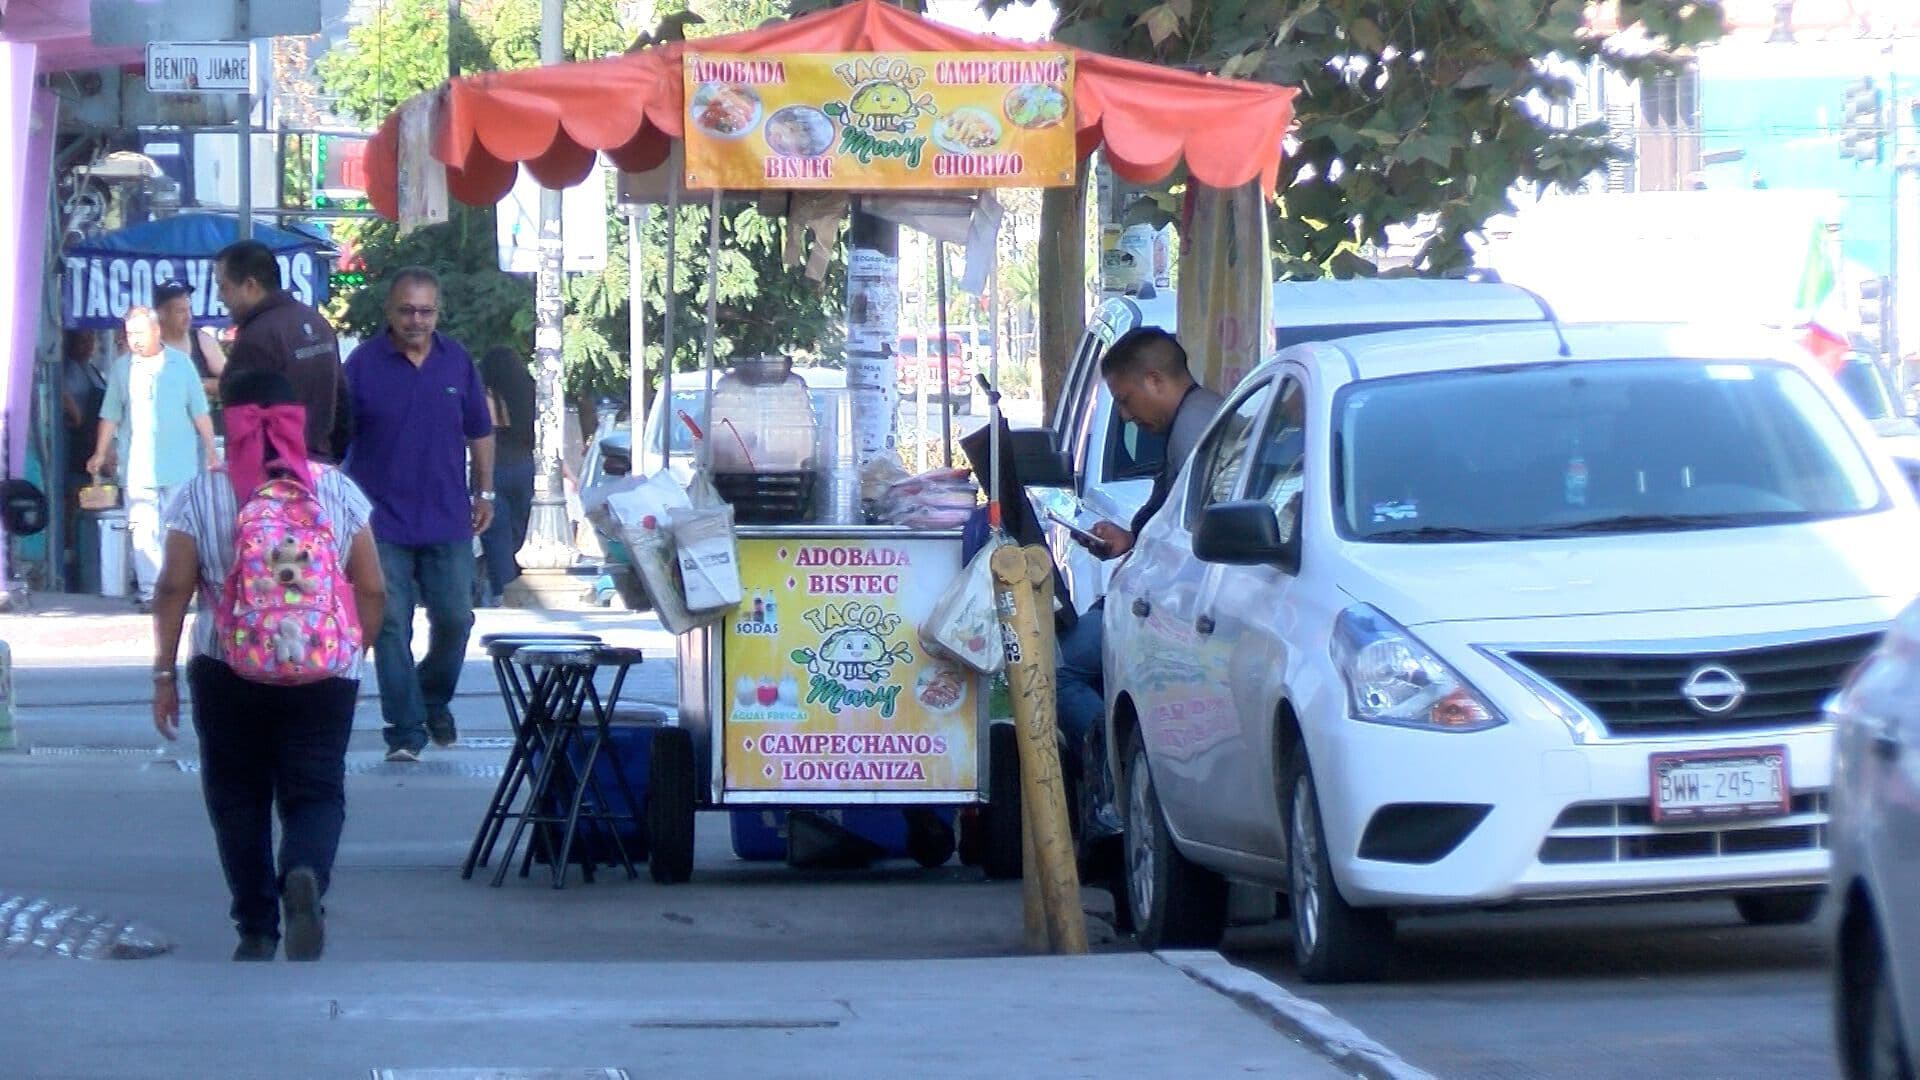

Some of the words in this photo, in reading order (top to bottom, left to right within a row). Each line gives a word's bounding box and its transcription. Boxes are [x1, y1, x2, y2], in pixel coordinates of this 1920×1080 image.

[154, 57, 199, 79] BENITO
[205, 58, 249, 79] JUARE
[692, 61, 786, 83] ADOBADA
[835, 57, 927, 88] TACOS
[936, 60, 1069, 84] CAMPECHANOS
[838, 128, 927, 166] Mary
[765, 157, 832, 178] BISTEC
[934, 154, 1023, 175] CHORIZO
[795, 547, 911, 567] ADOBADA
[809, 575, 898, 594] BISTEC
[736, 623, 778, 634] SODAS
[803, 601, 902, 637] TACOS
[806, 674, 902, 718] Mary
[759, 734, 947, 755] CAMPECHANOS
[783, 761, 925, 781] LONGANIZA
[1660, 768, 1780, 802] BWW-245-A
